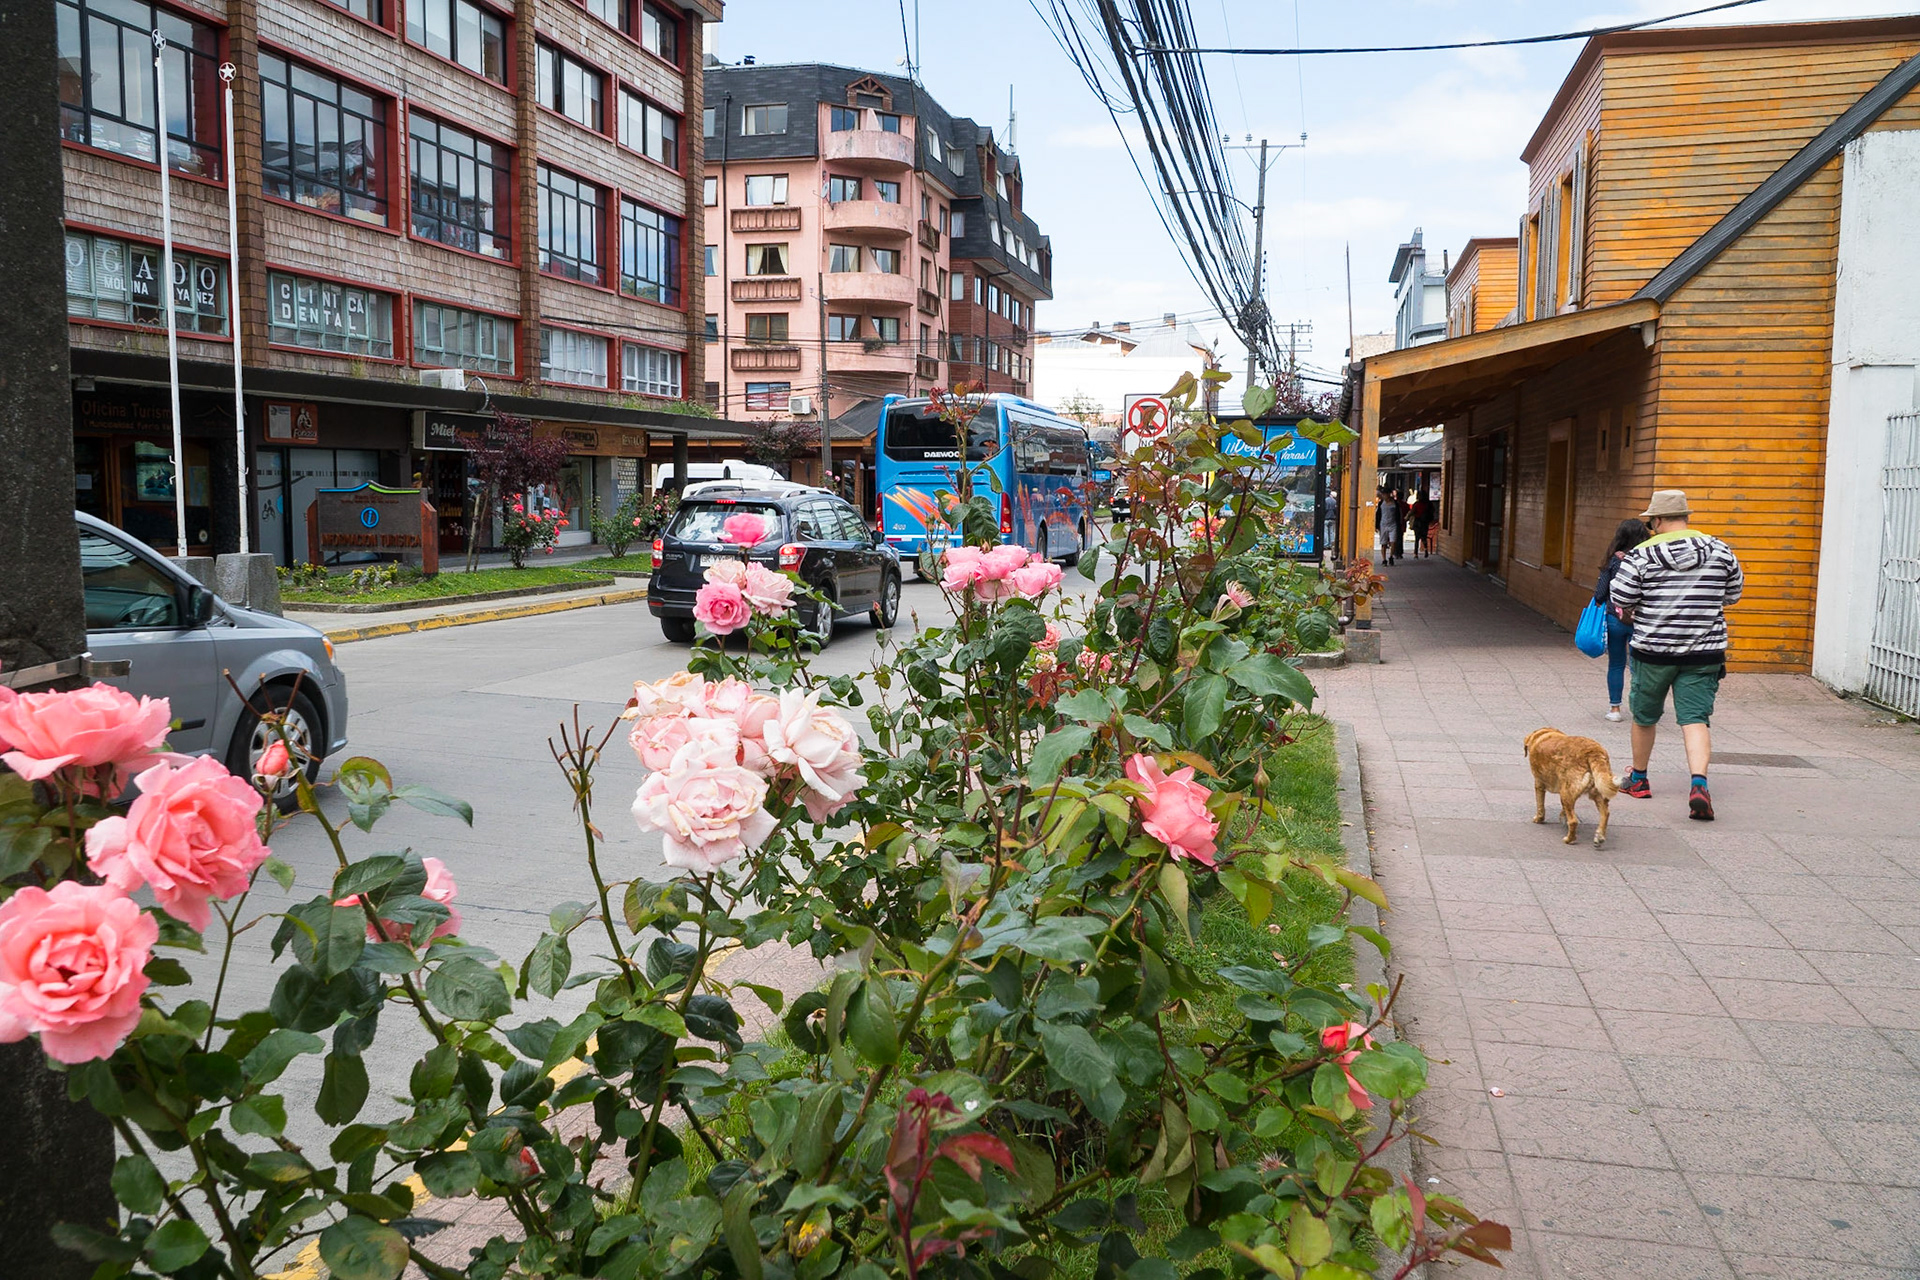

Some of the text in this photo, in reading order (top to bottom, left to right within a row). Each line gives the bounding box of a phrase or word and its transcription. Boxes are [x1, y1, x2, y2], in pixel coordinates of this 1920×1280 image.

[65, 241, 216, 290] OGADO
[104, 276, 149, 296] MOLINA
[281, 283, 365, 314] CLINICA
[281, 302, 357, 331] DENTAL
[130, 401, 172, 419] Turism
[430, 422, 456, 437] Miel
